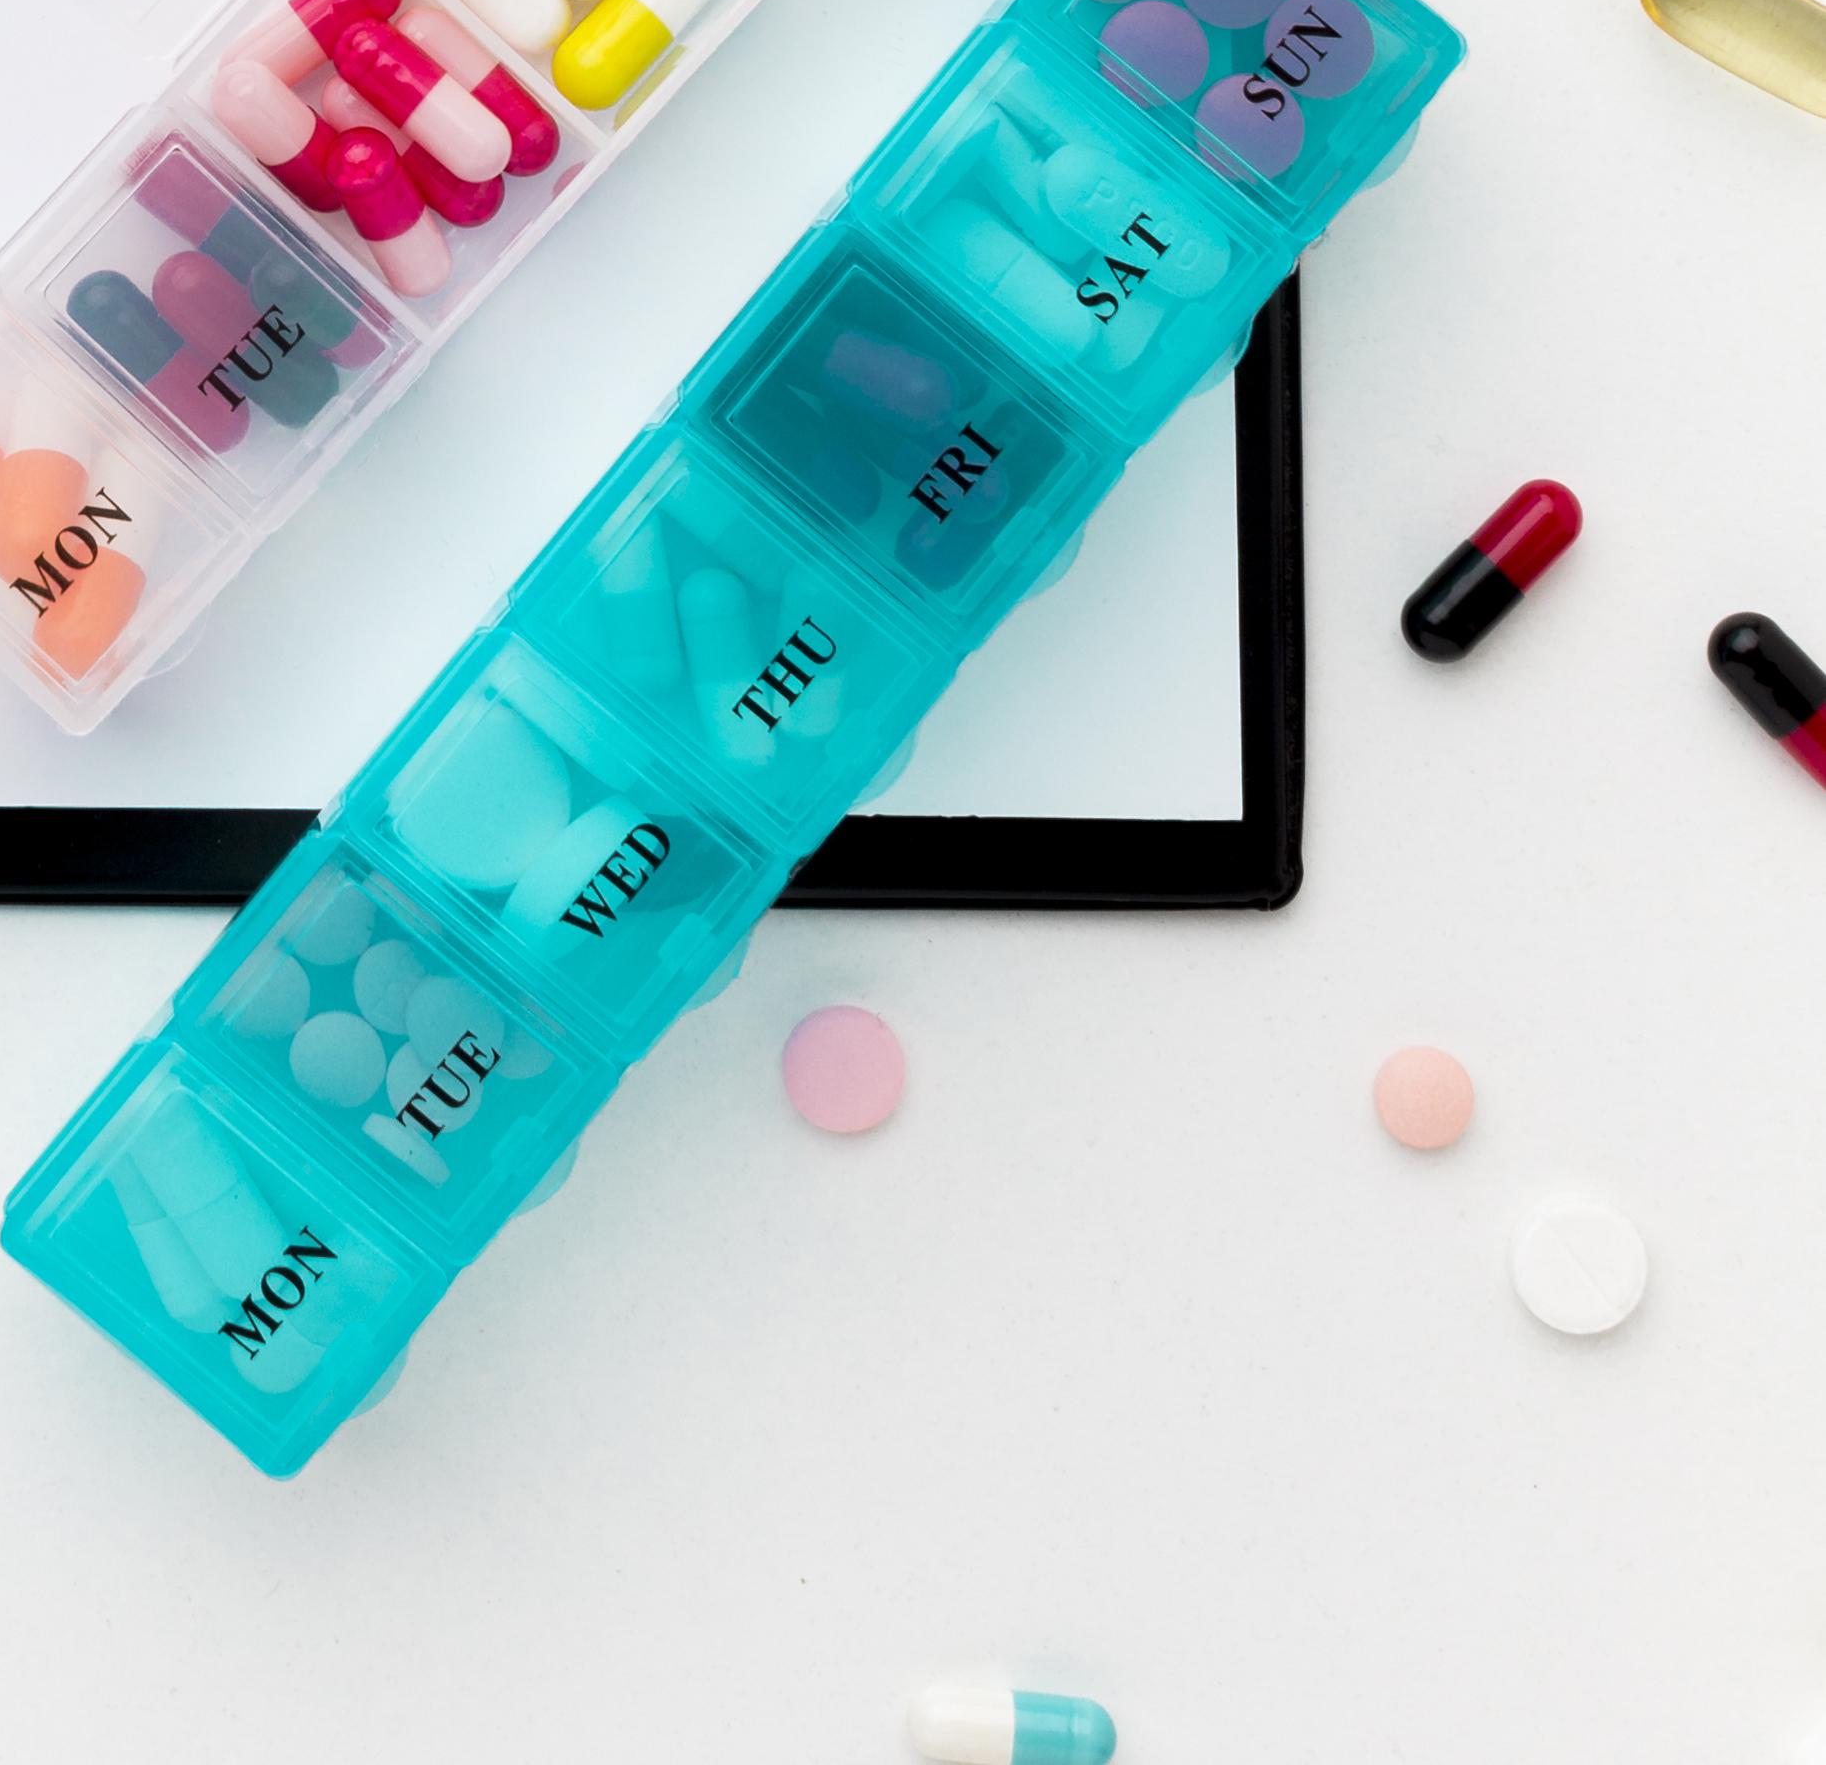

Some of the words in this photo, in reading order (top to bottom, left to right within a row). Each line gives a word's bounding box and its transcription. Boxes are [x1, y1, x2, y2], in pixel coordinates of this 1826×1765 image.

[1242, 5, 1343, 121] SUN
[1076, 212, 1168, 324] SAT
[197, 304, 306, 412] TUE
[909, 422, 1002, 523] FRI
[8, 487, 133, 619] MON
[732, 616, 836, 731] THU
[559, 823, 671, 938] WED
[396, 1030, 501, 1140] TUE
[218, 1226, 337, 1360] MON
